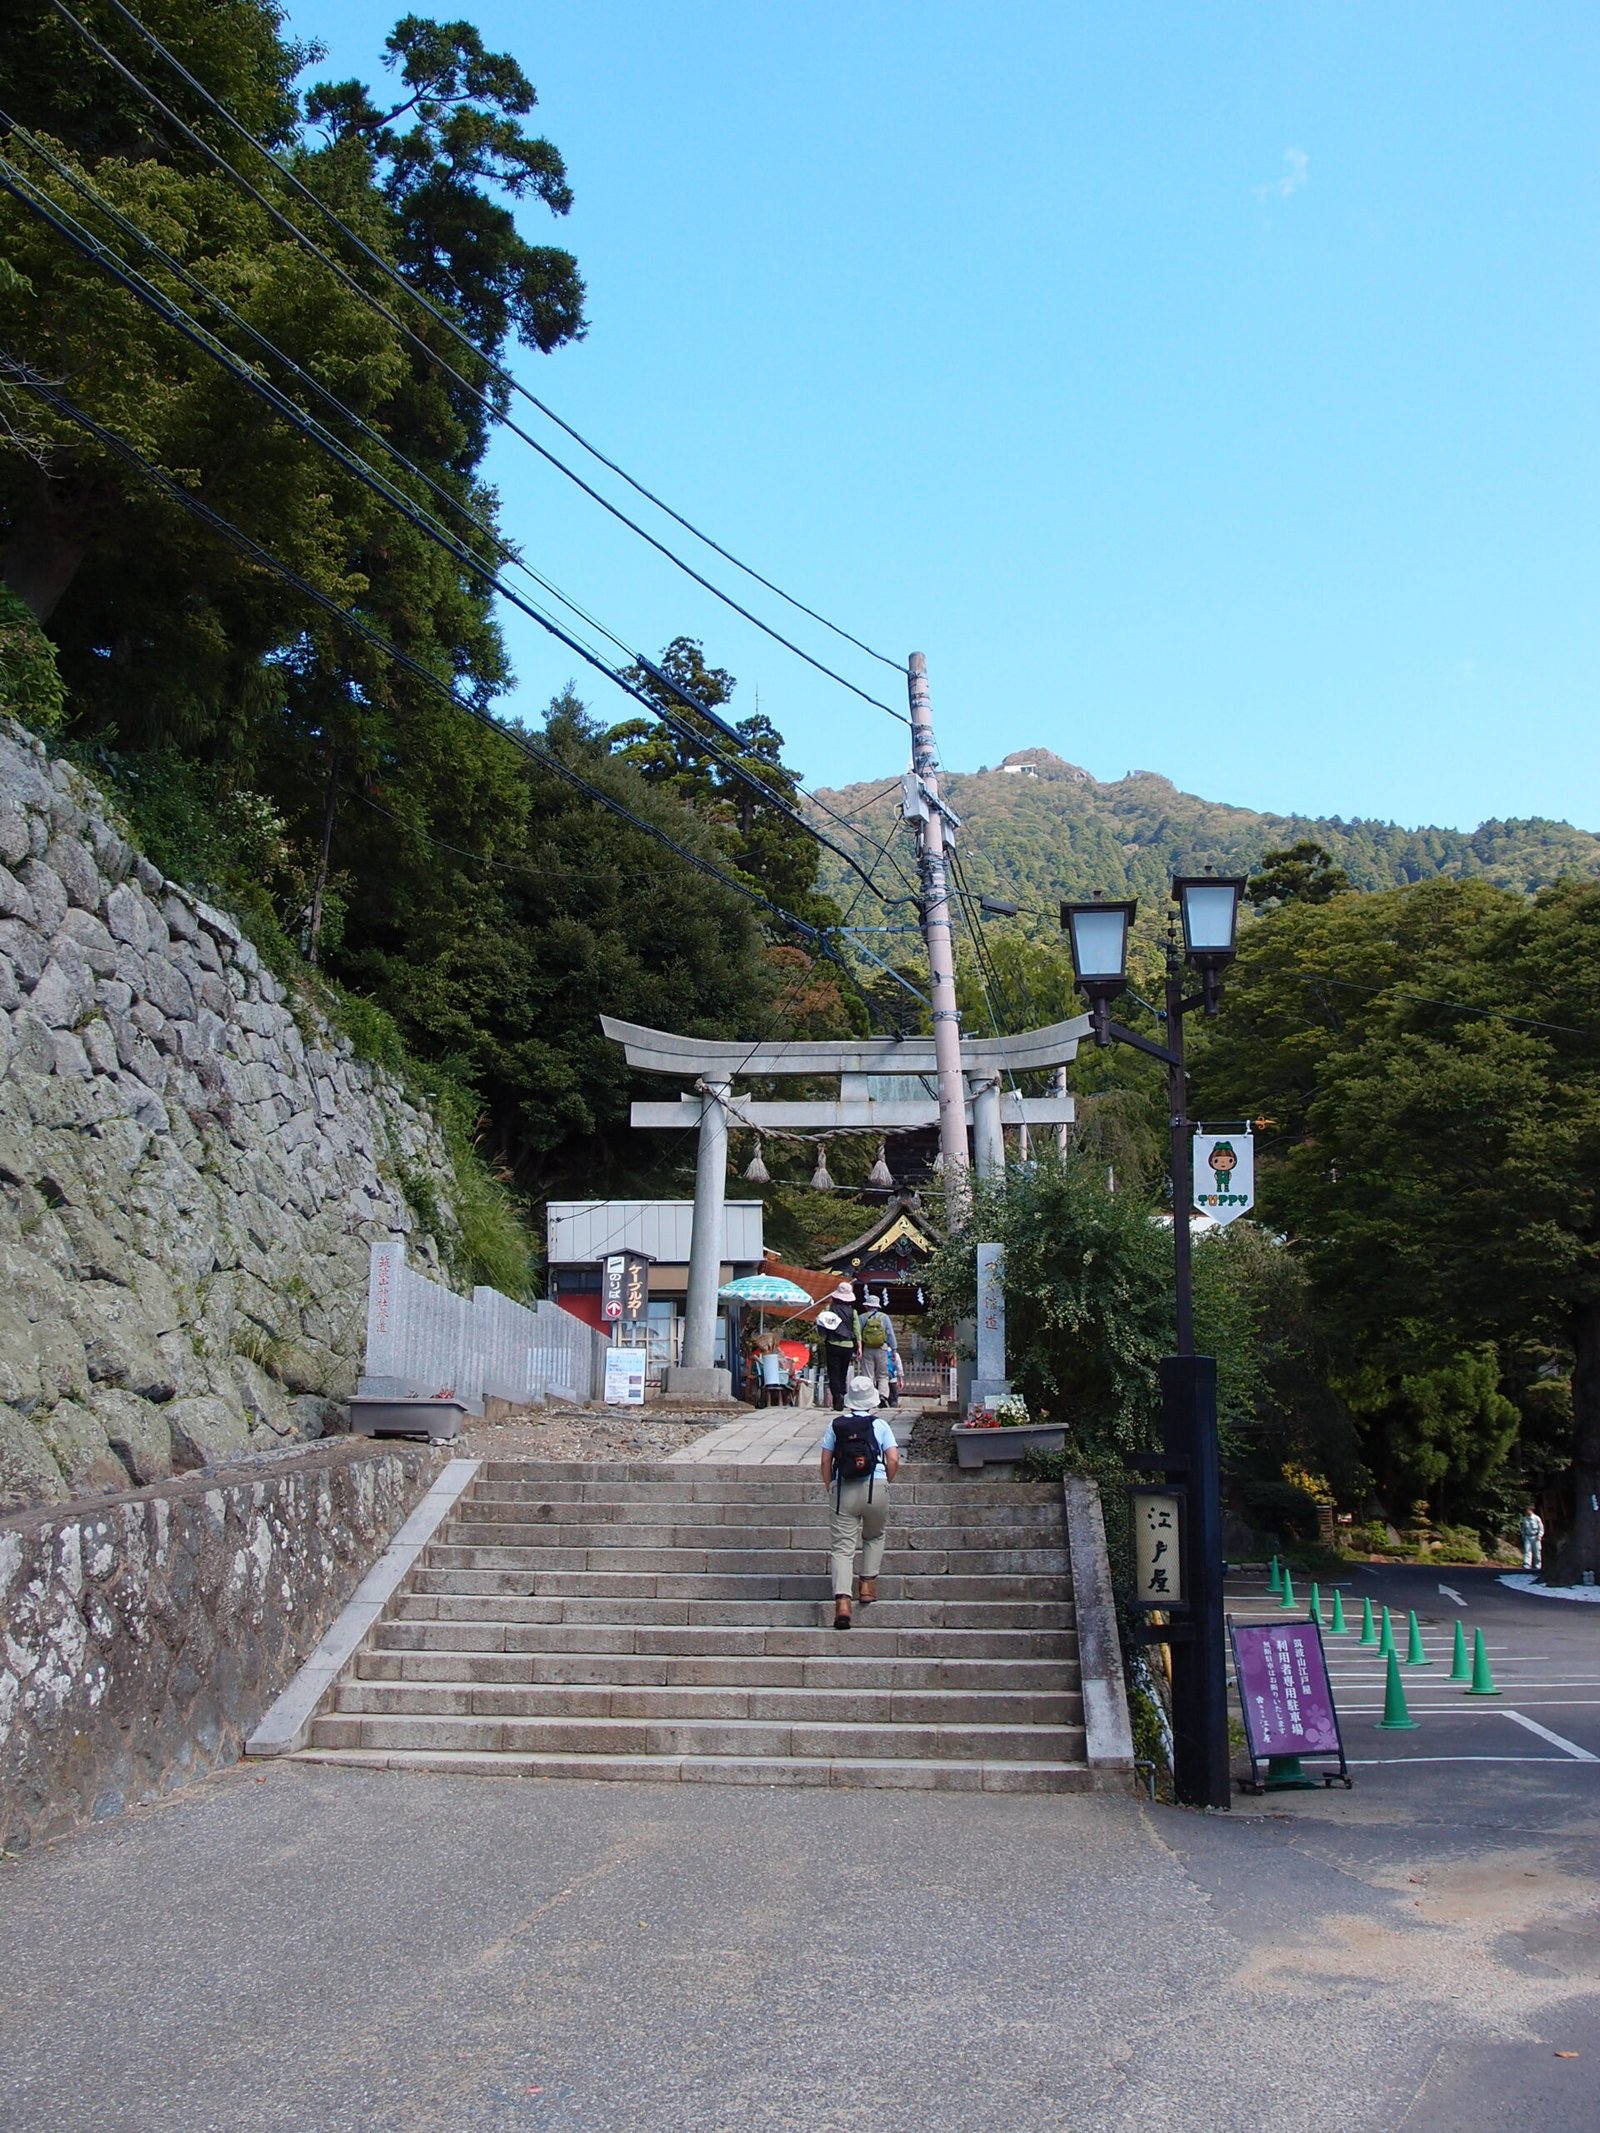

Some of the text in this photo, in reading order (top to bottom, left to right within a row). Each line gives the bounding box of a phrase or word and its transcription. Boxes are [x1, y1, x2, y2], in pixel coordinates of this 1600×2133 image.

[1198, 1195, 1248, 1206] TUPPY
[609, 1273, 621, 1299] のりば
[628, 1264, 643, 1318] ケーブルカー
[1147, 1507, 1172, 1593] 江戸屋
[1276, 1639, 1304, 1736] 利用者専用駐車場
[1293, 1638, 1312, 1695] 筑波山江戸屋
